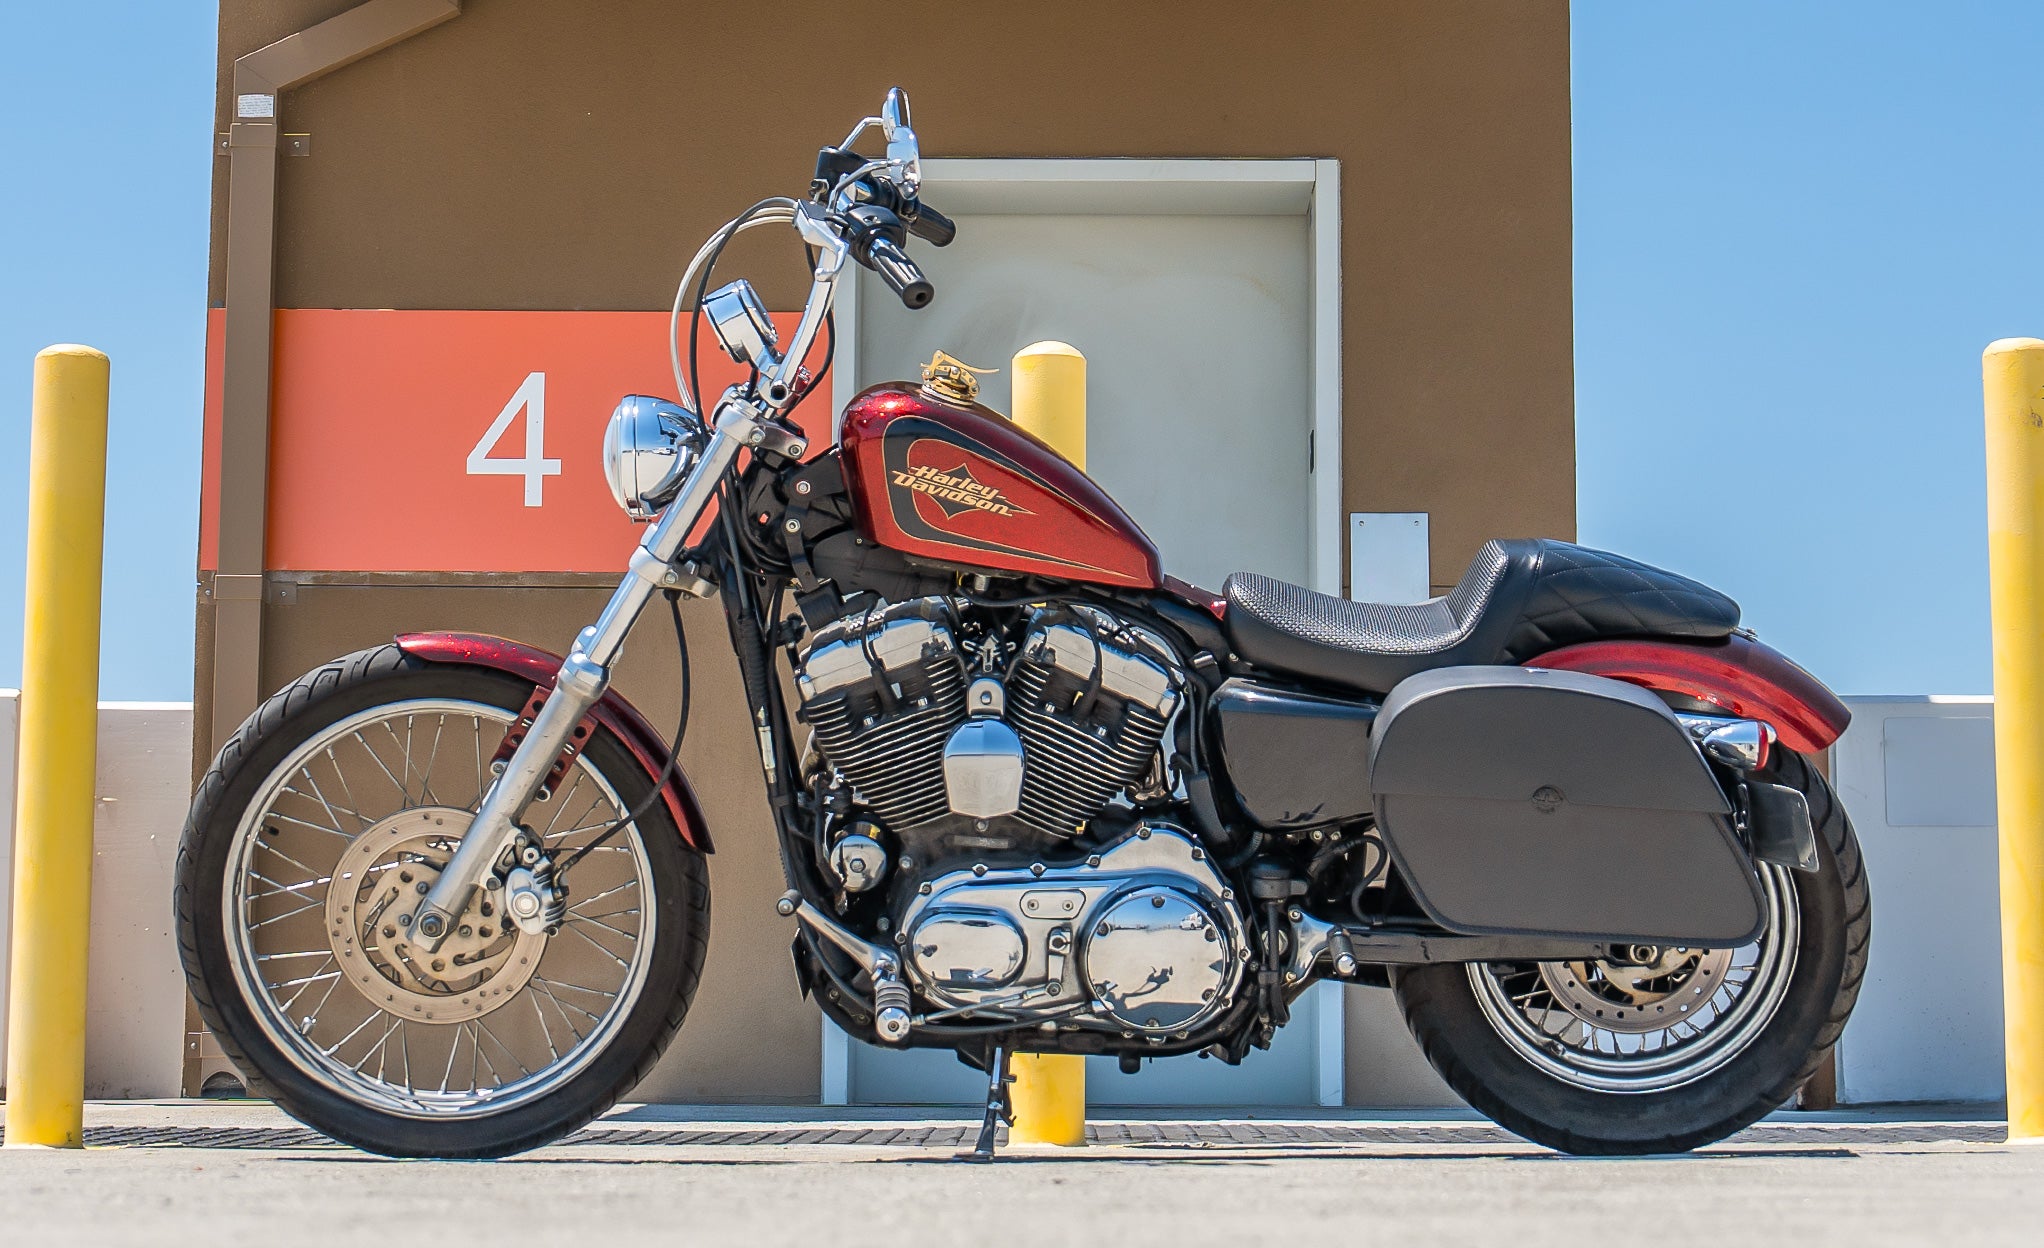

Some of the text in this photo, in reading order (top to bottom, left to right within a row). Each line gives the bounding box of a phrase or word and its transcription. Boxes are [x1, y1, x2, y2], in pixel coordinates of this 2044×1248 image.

[466, 371, 562, 507] 4
[892, 470, 1013, 517] Davidson
[911, 465, 1007, 500] Harley
